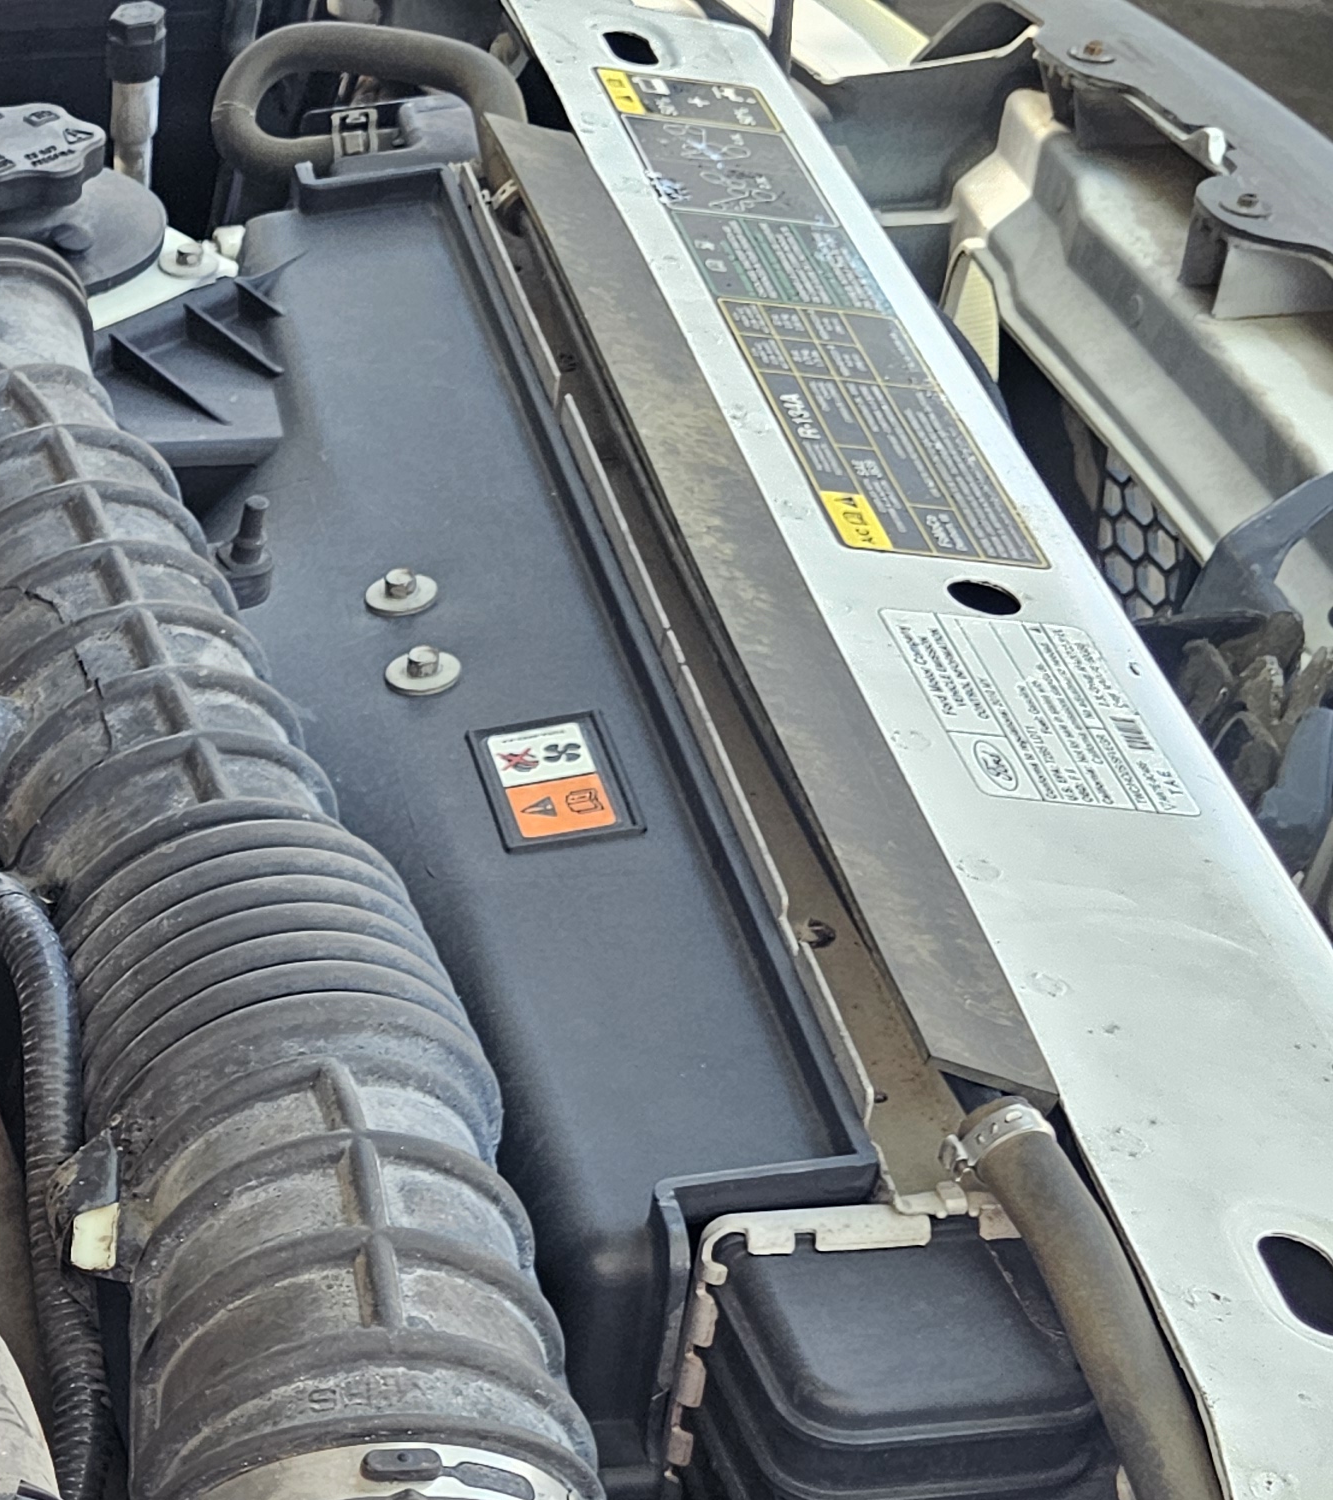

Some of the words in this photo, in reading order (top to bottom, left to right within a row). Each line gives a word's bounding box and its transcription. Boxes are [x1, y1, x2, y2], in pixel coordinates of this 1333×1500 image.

[778, 393, 823, 439] R-134A
[894, 624, 930, 666] Company
[916, 666, 944, 693] Motor
[933, 695, 957, 716] Ford
